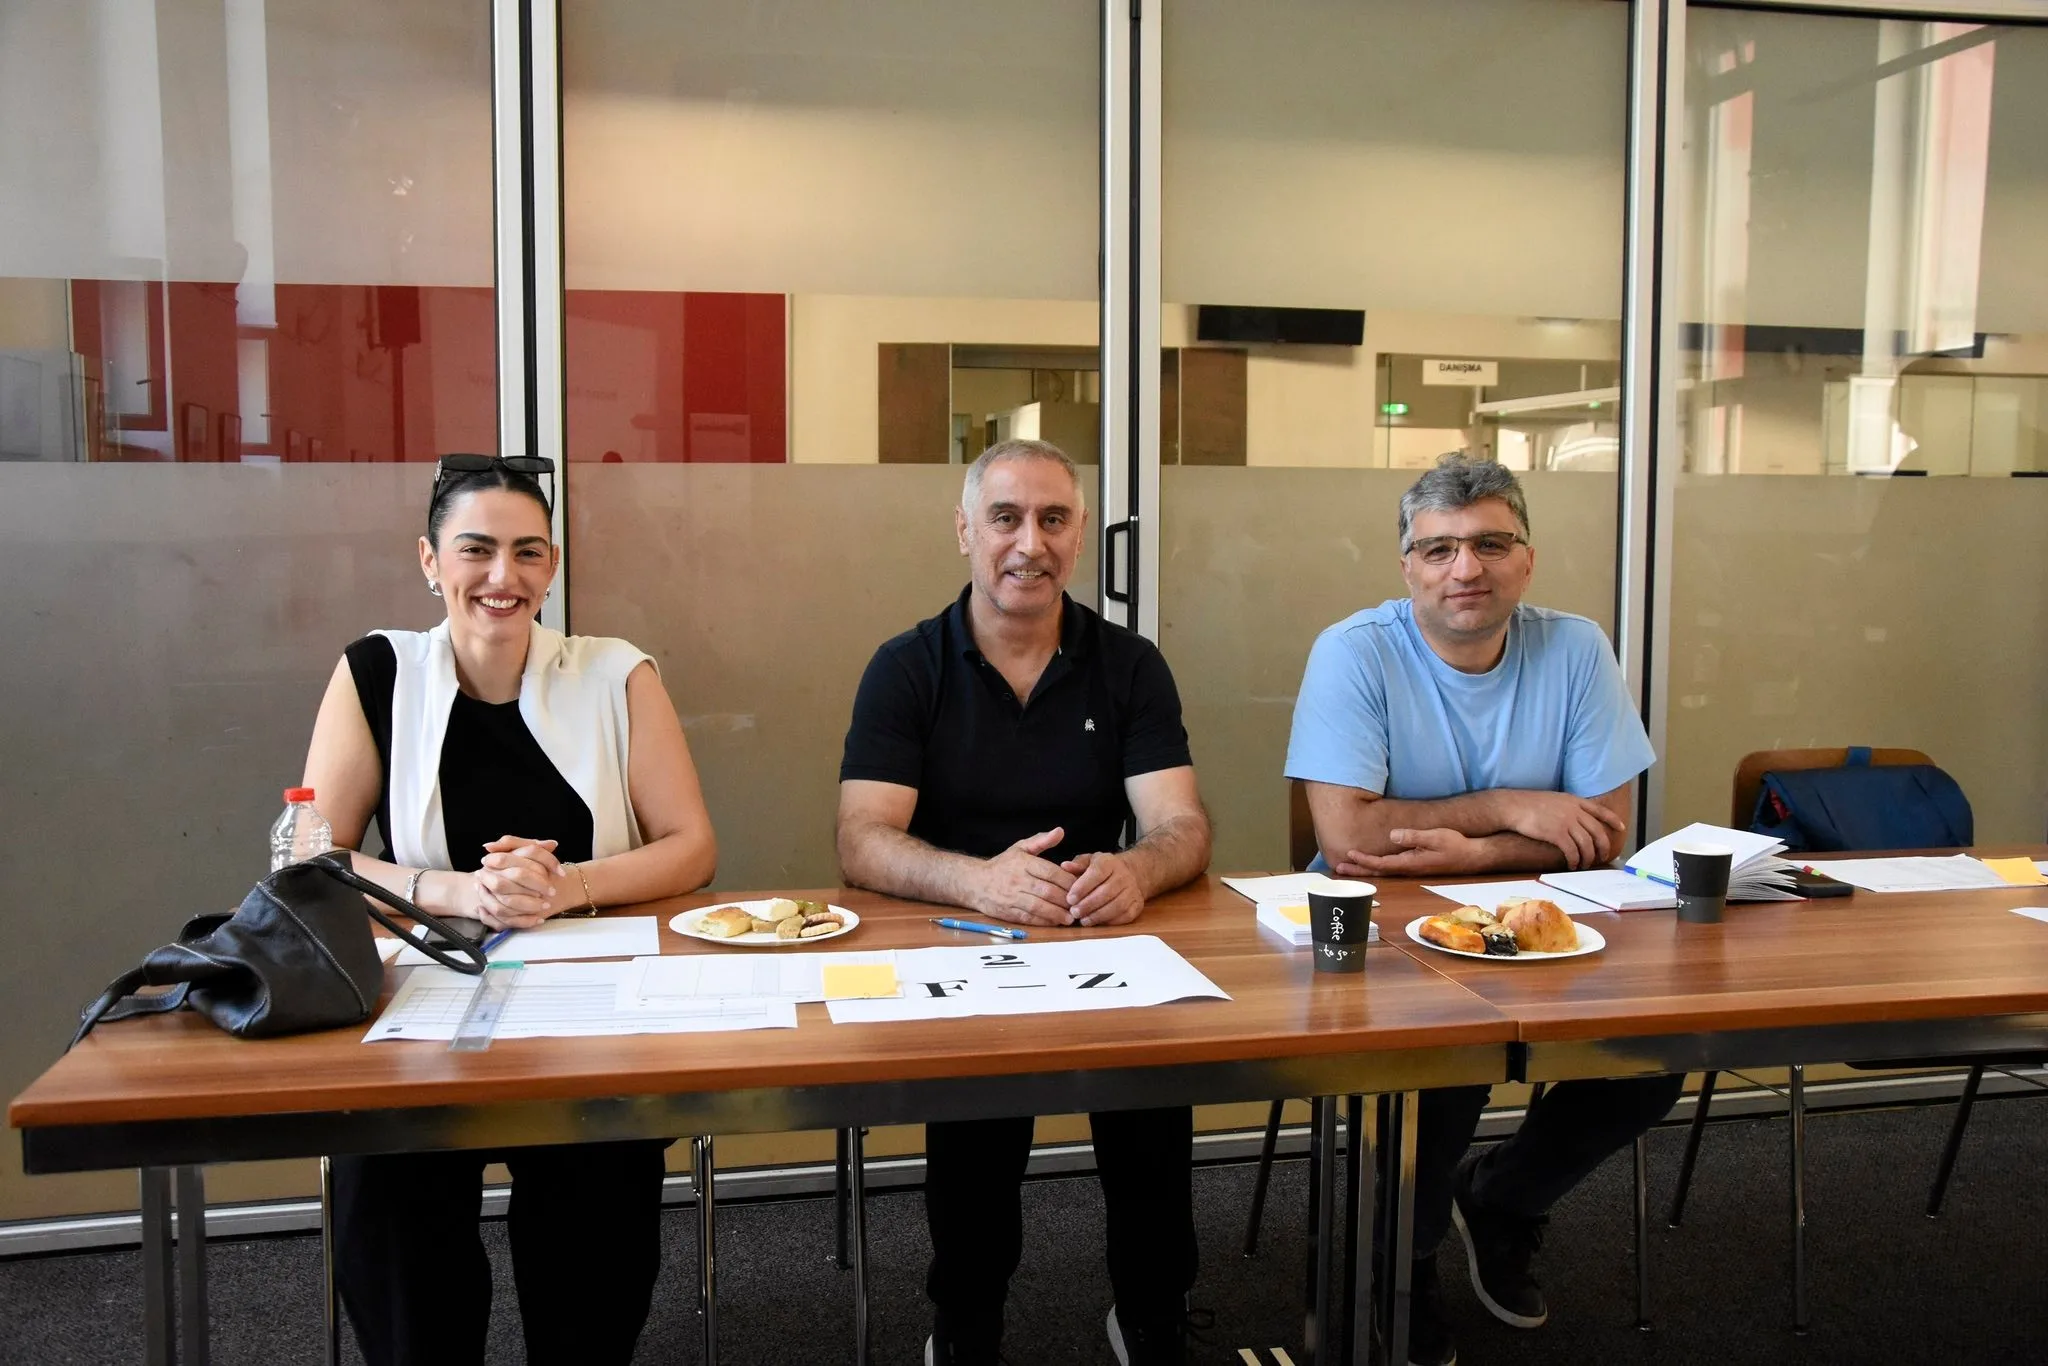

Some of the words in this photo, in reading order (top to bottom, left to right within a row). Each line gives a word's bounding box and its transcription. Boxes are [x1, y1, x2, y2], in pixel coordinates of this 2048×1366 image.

[1439, 363, 1482, 374] DANIŞMA
[1330, 907, 1344, 941] Coffee
[980, 954, 1025, 965] 2
[1323, 944, 1334, 958] to
[1336, 949, 1348, 961] go
[917, 979, 968, 998] F
[1068, 972, 1128, 989] Z
